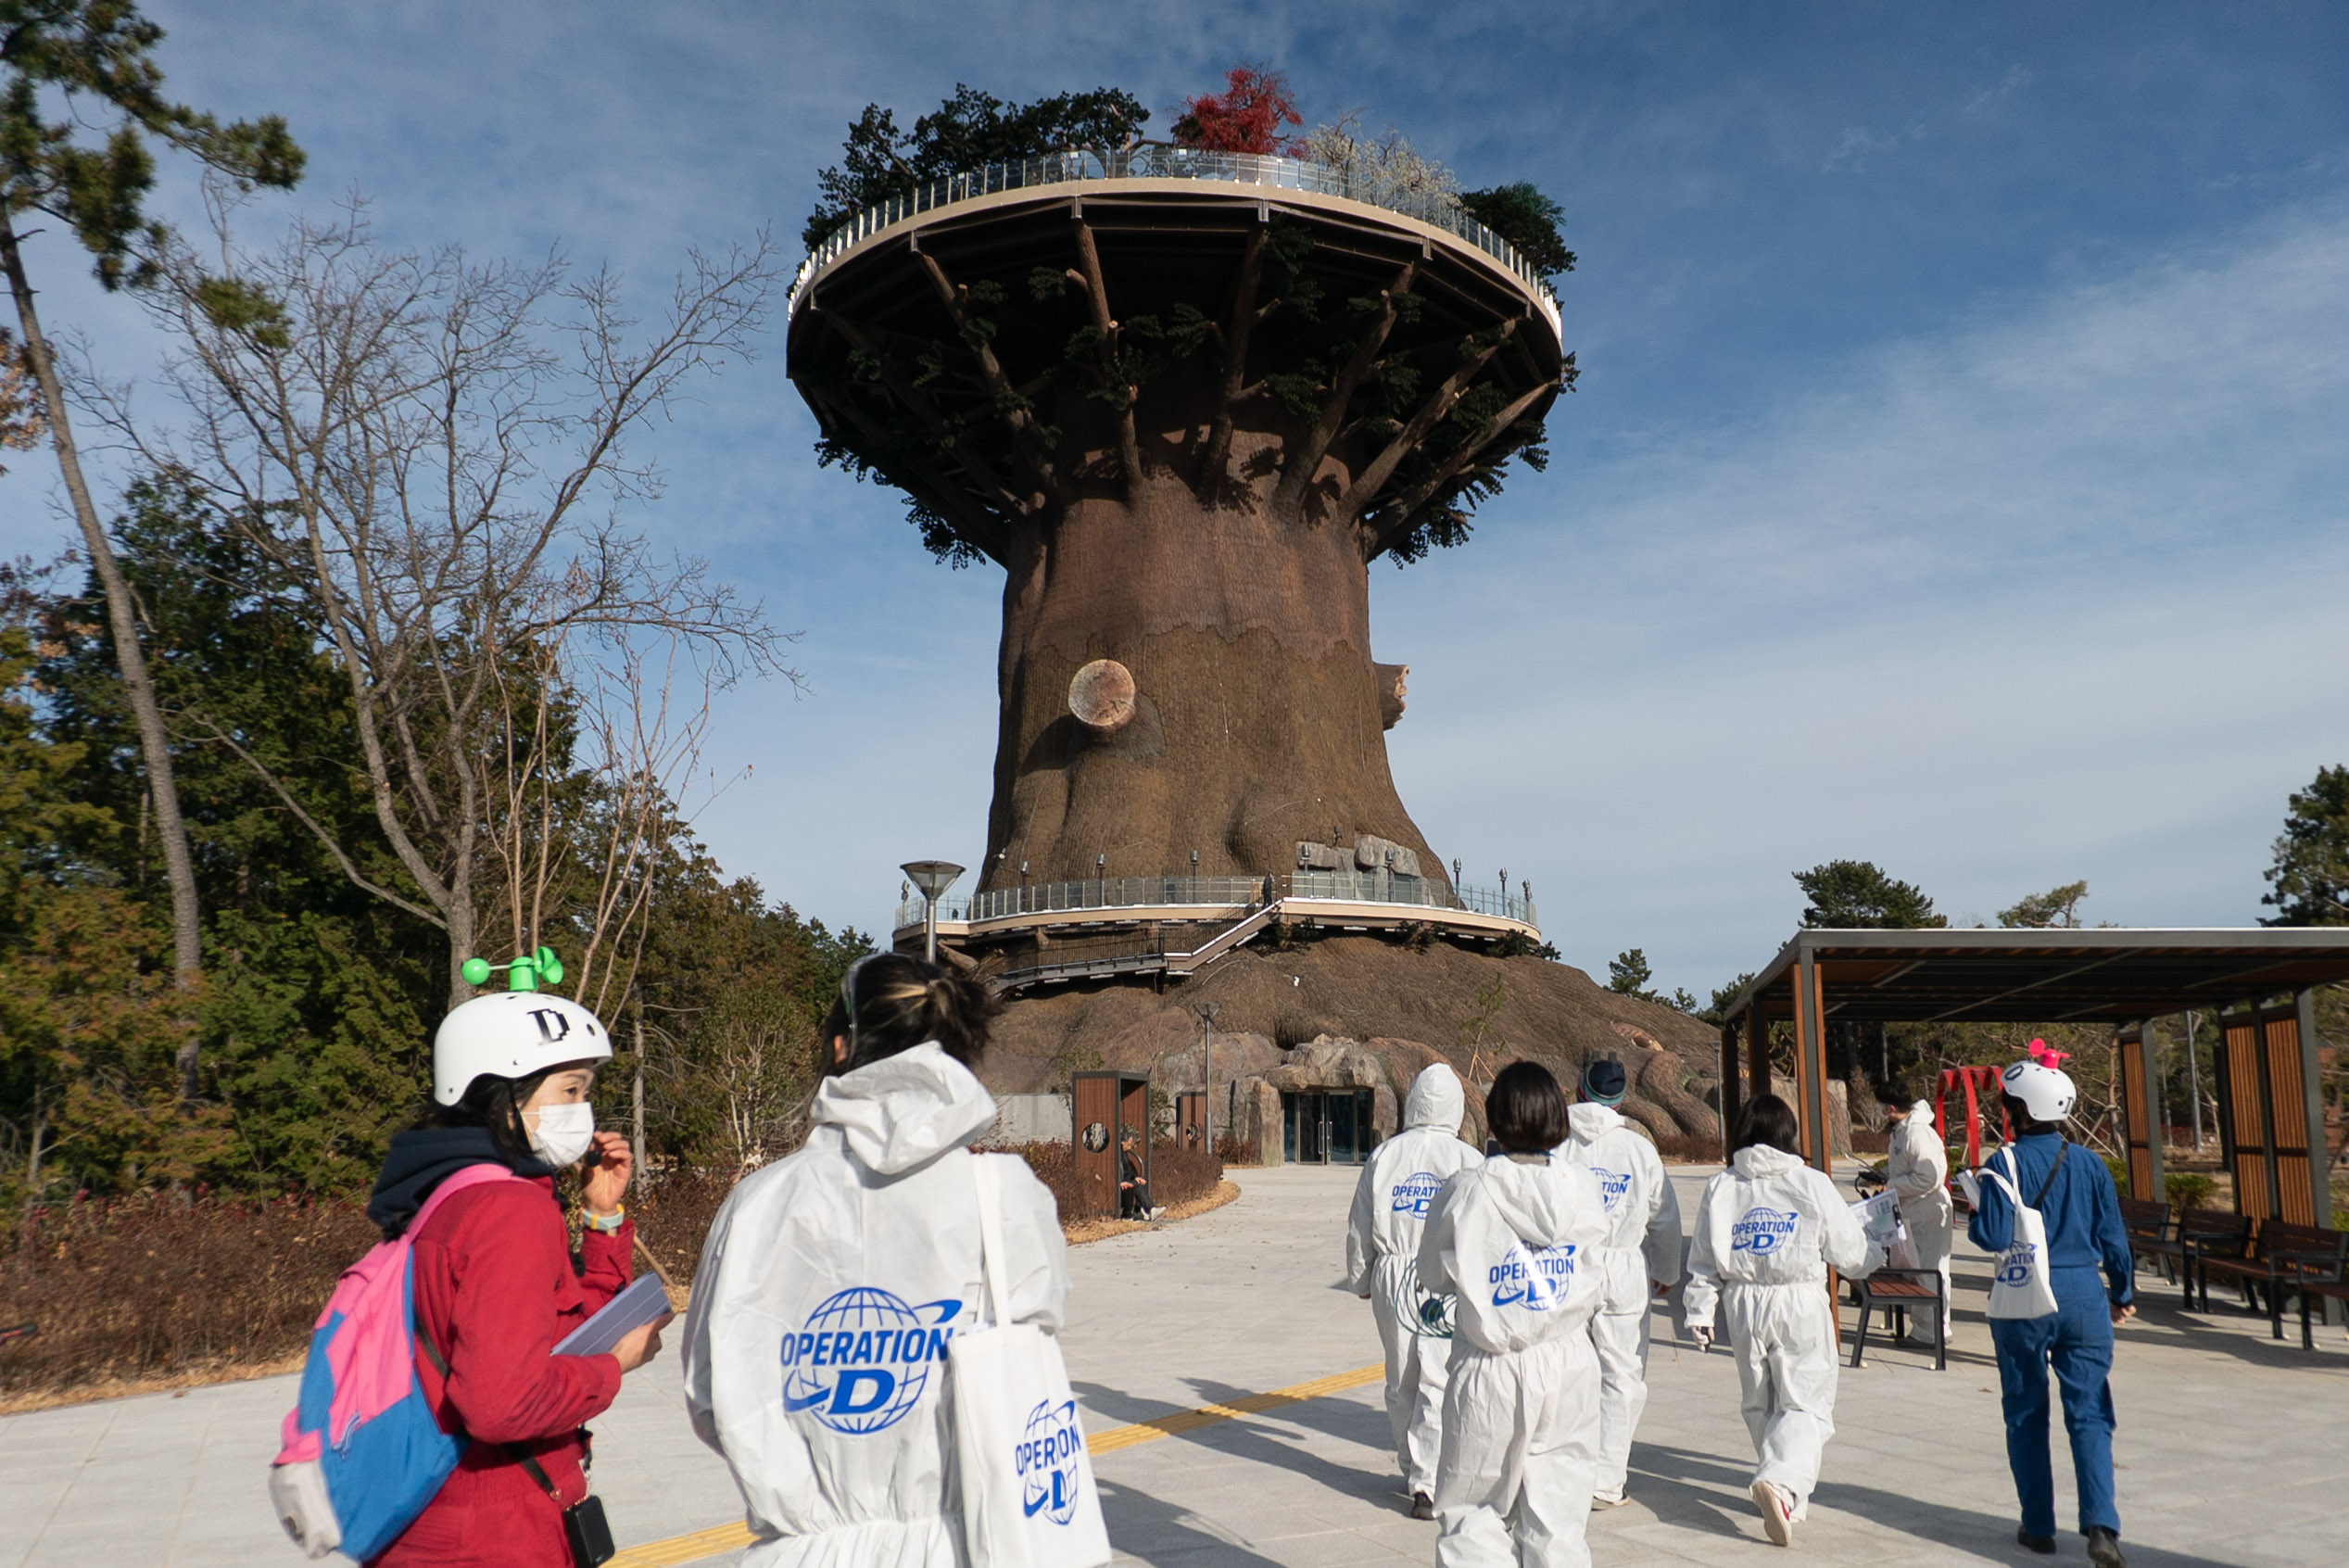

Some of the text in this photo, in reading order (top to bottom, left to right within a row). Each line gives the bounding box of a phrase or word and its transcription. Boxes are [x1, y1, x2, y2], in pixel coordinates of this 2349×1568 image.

[526, 1008, 570, 1046] D
[1392, 1185, 1443, 1197] OPERATI
[1601, 1182, 1628, 1194] TION
[1731, 1221, 1795, 1235] OPERATION
[1751, 1234, 1774, 1249] D
[2008, 1266, 2027, 1282] D
[779, 1327, 954, 1367] OPERATION
[827, 1369, 896, 1415] D
[1016, 1424, 1081, 1476] OPERON
